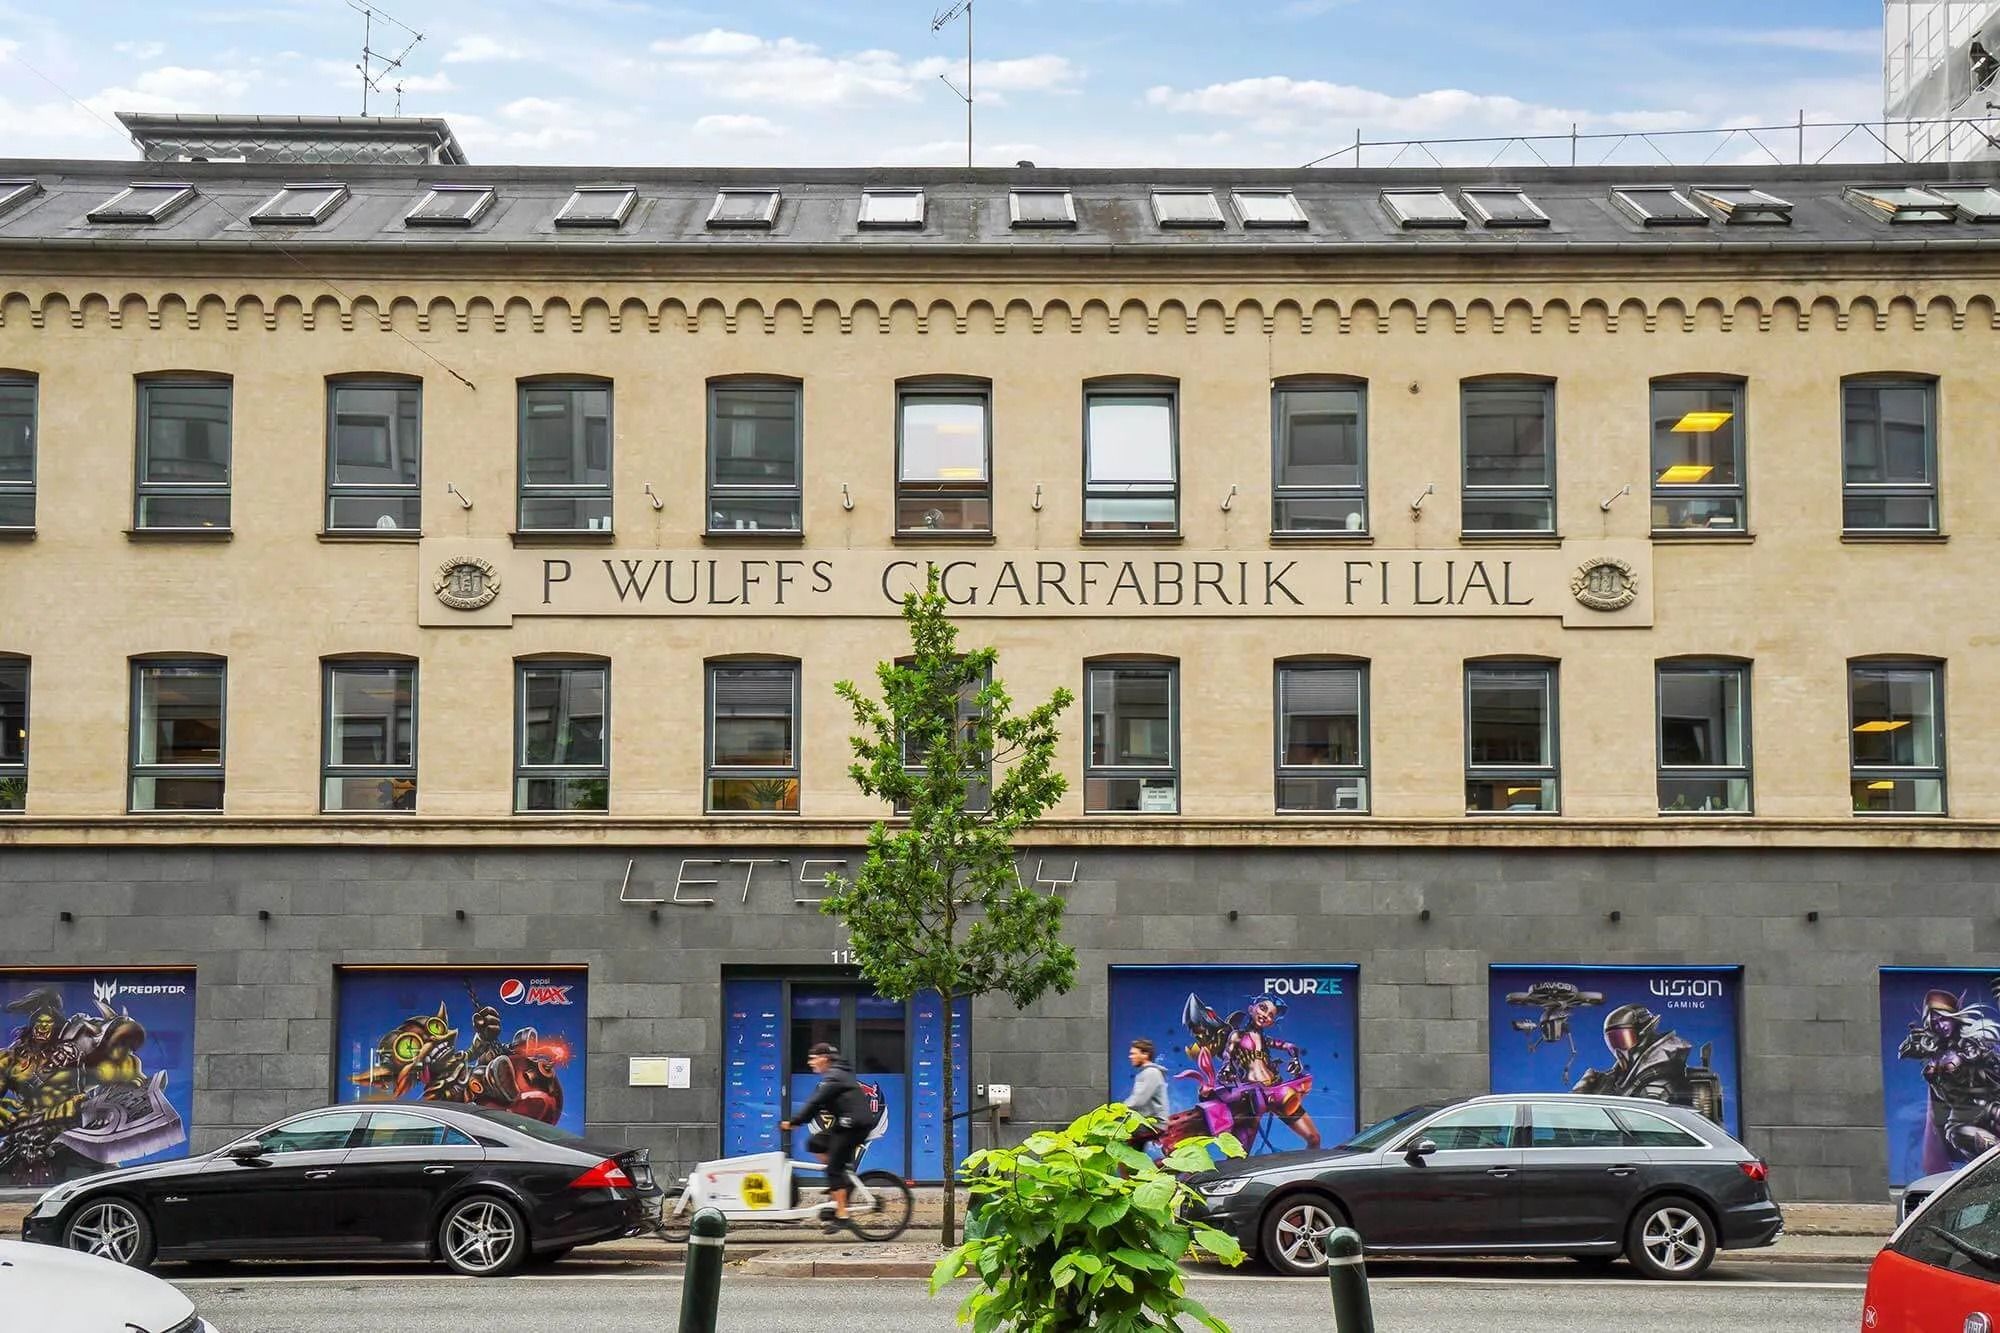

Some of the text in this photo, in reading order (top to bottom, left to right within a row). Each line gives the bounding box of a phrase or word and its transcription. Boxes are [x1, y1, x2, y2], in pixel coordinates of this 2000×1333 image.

[542, 559, 572, 604] P
[601, 559, 834, 604] WULFFS
[1343, 560, 1534, 605] FILIAL
[530, 977, 551, 985] pepsi
[1263, 978, 1343, 995] FOURZE
[119, 985, 186, 995] PREDATOR
[524, 985, 574, 1005] MAX
[1667, 1000, 1705, 1009] GAMING
[1865, 1308, 1877, 1326] DK
